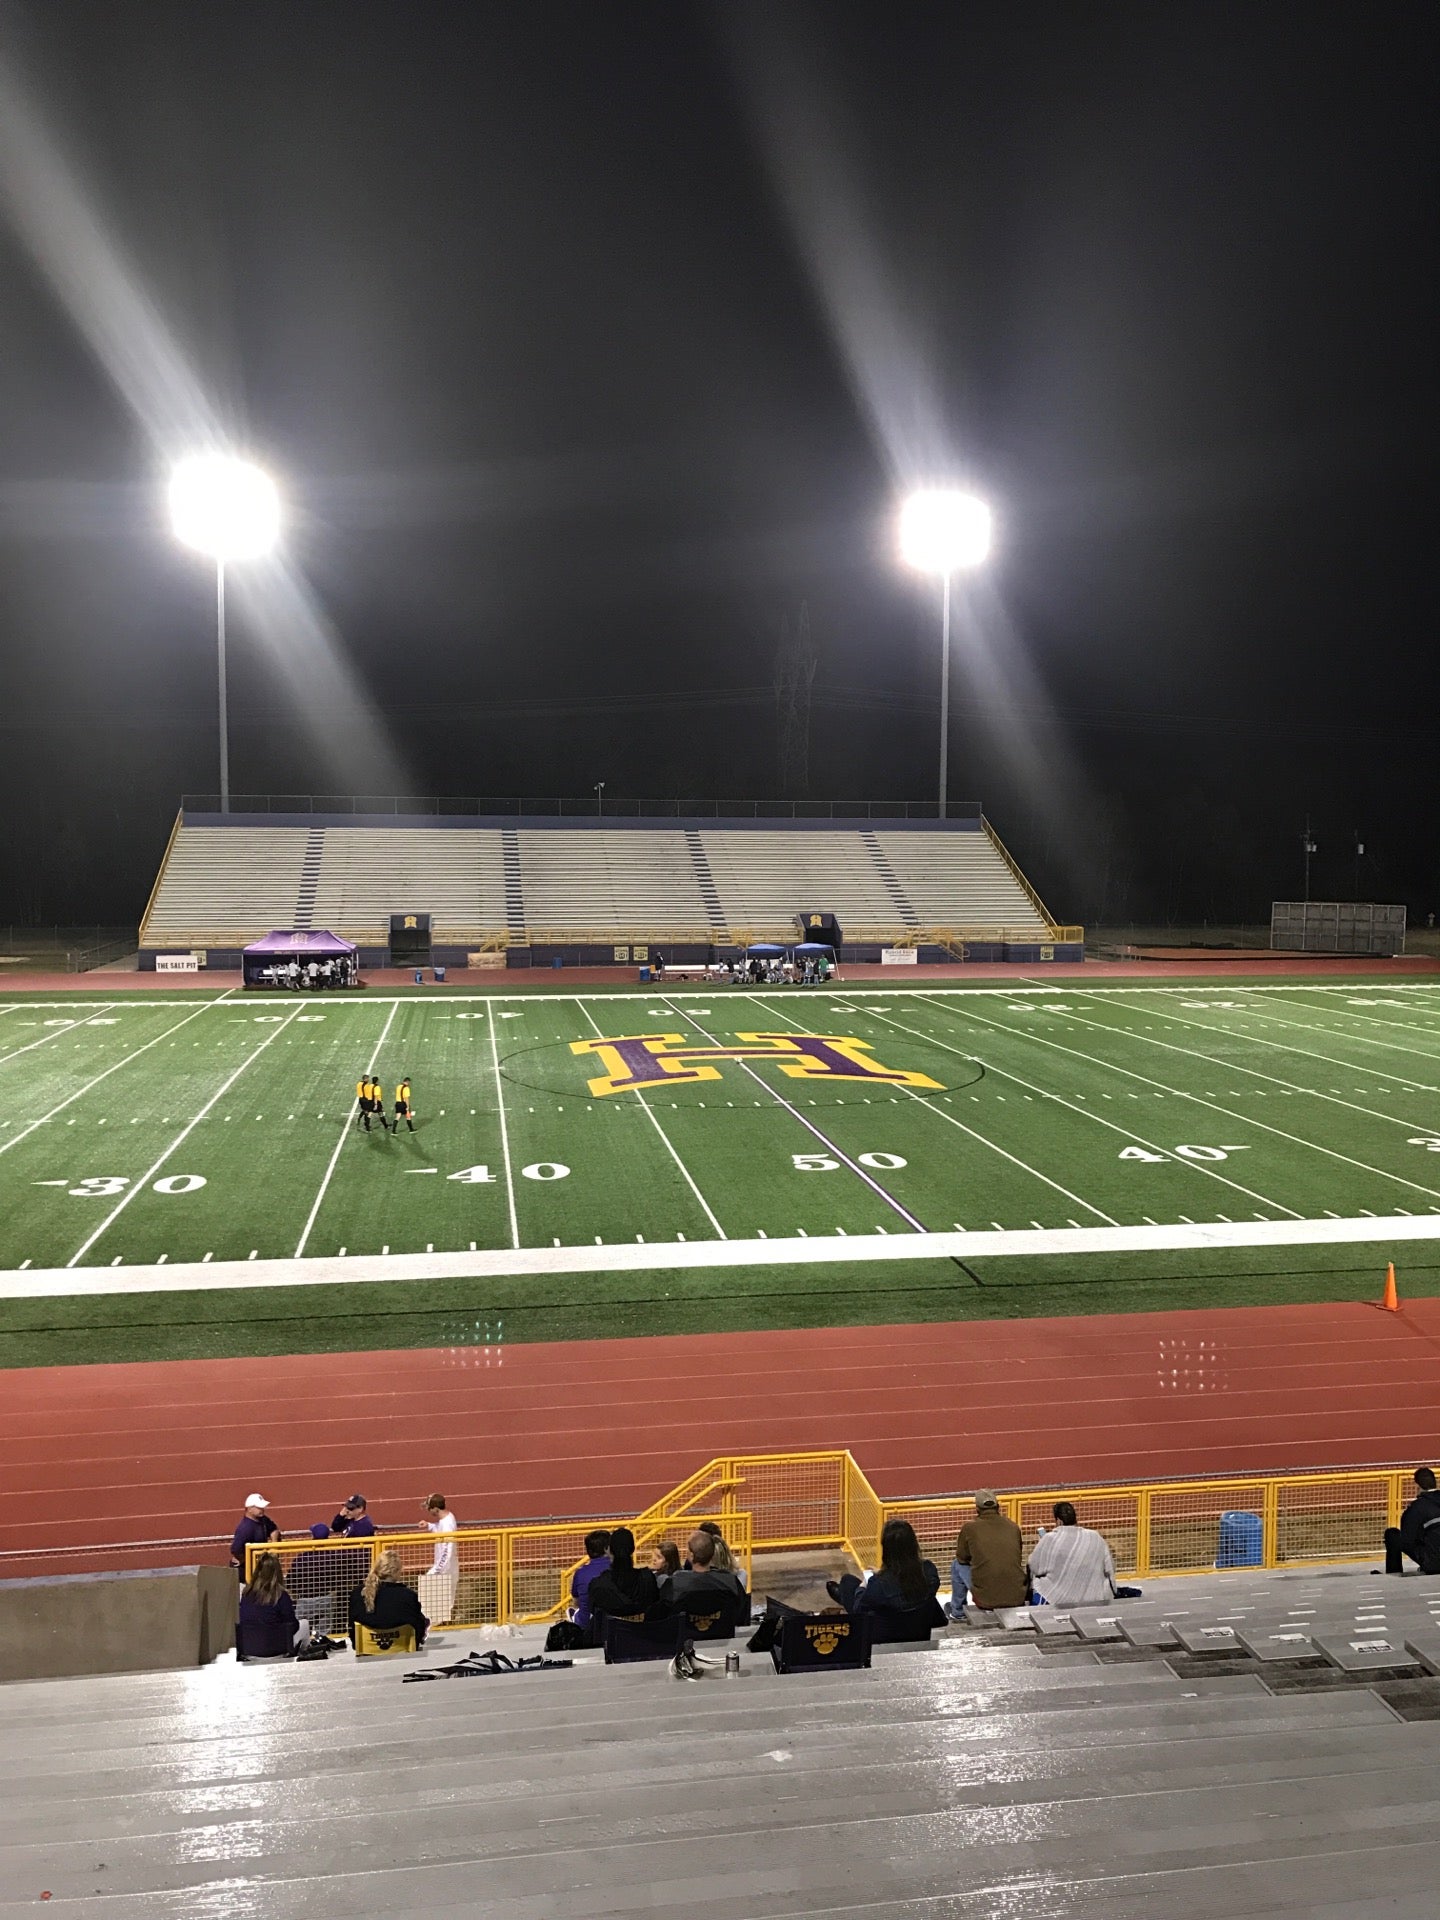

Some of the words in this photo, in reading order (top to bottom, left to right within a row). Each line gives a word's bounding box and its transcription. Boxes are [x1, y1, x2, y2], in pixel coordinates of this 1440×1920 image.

[791, 1152, 908, 1171] 50
[1118, 1144, 1228, 1163] 40
[446, 1162, 571, 1184] 40
[68, 1174, 207, 1196] 30
[804, 1623, 850, 1639] TIGERS
